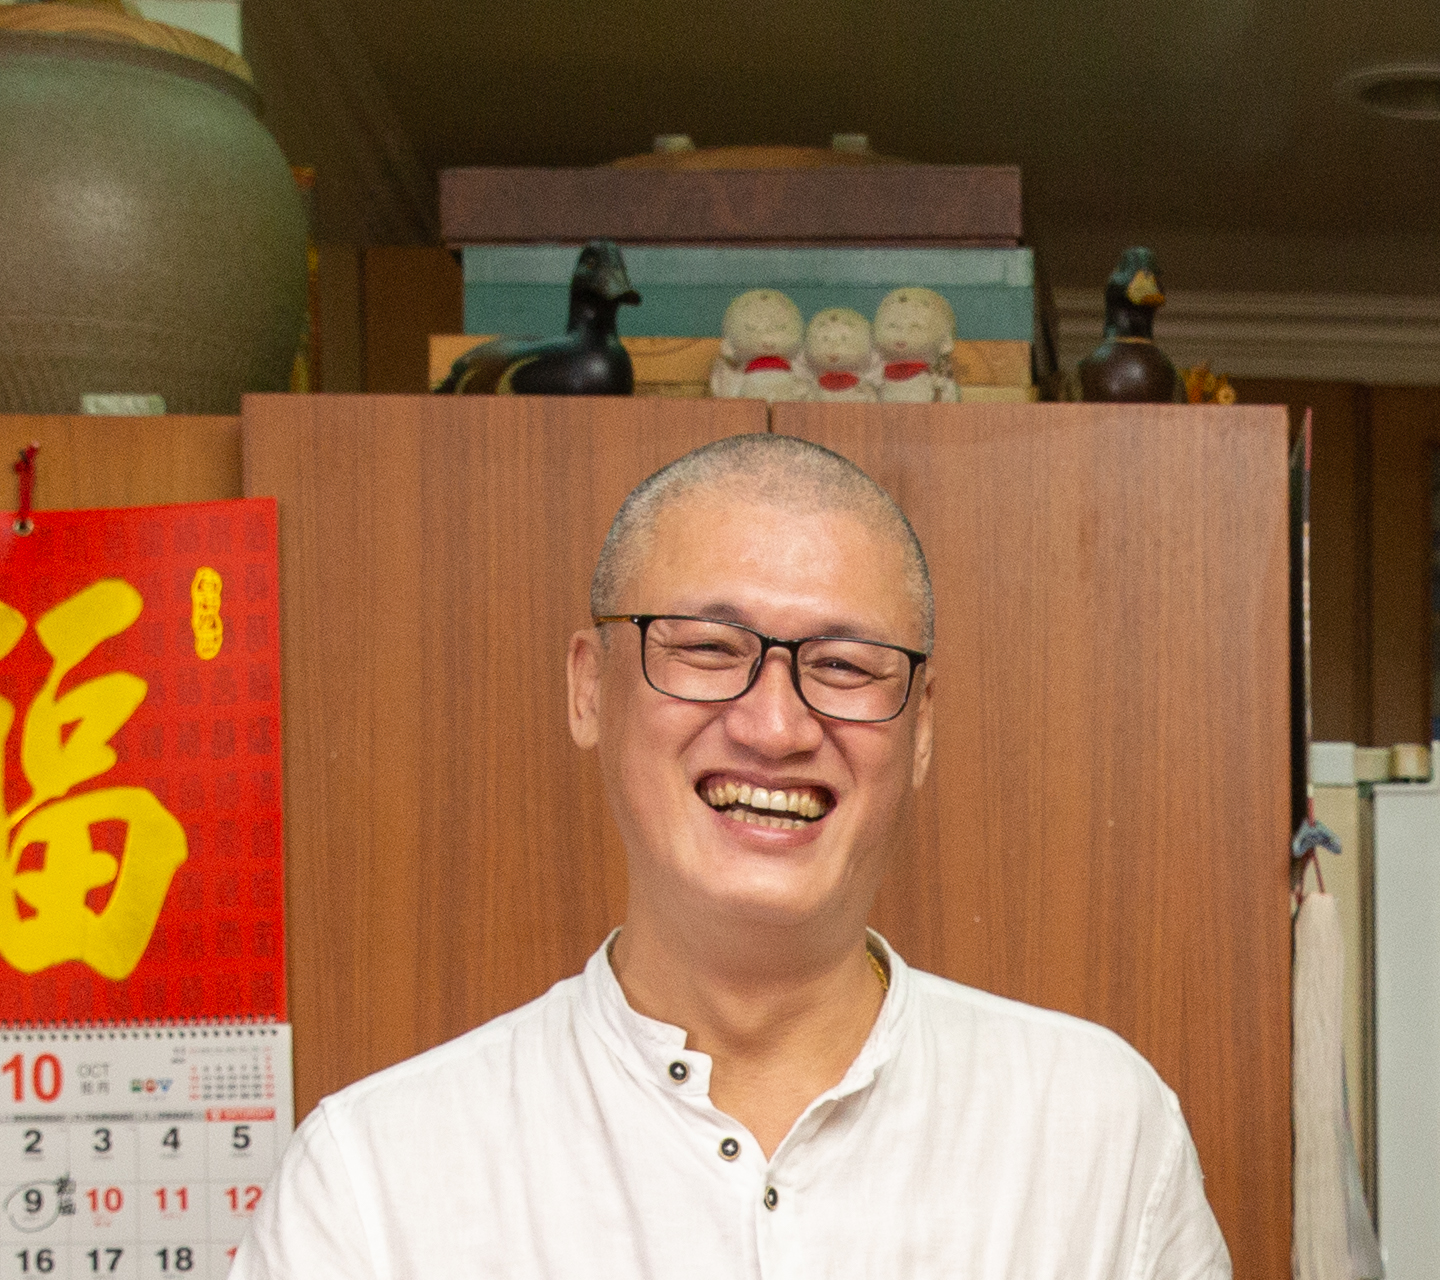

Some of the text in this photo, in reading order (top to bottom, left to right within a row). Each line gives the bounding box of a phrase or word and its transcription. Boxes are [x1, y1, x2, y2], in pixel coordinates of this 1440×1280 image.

[2, 1053, 63, 1102] 10
[77, 1062, 109, 1078] OCT
[24, 1129, 42, 1154] 2
[93, 1127, 112, 1154] 3
[162, 1127, 180, 1151] 4
[233, 1125, 251, 1150] 5
[23, 1188, 43, 1214] 9
[87, 1187, 124, 1213] 10
[155, 1187, 188, 1211] 11
[227, 1186, 263, 1211] 12
[17, 1248, 54, 1274] 16
[88, 1248, 124, 1272] 17
[157, 1246, 194, 1272] 18
